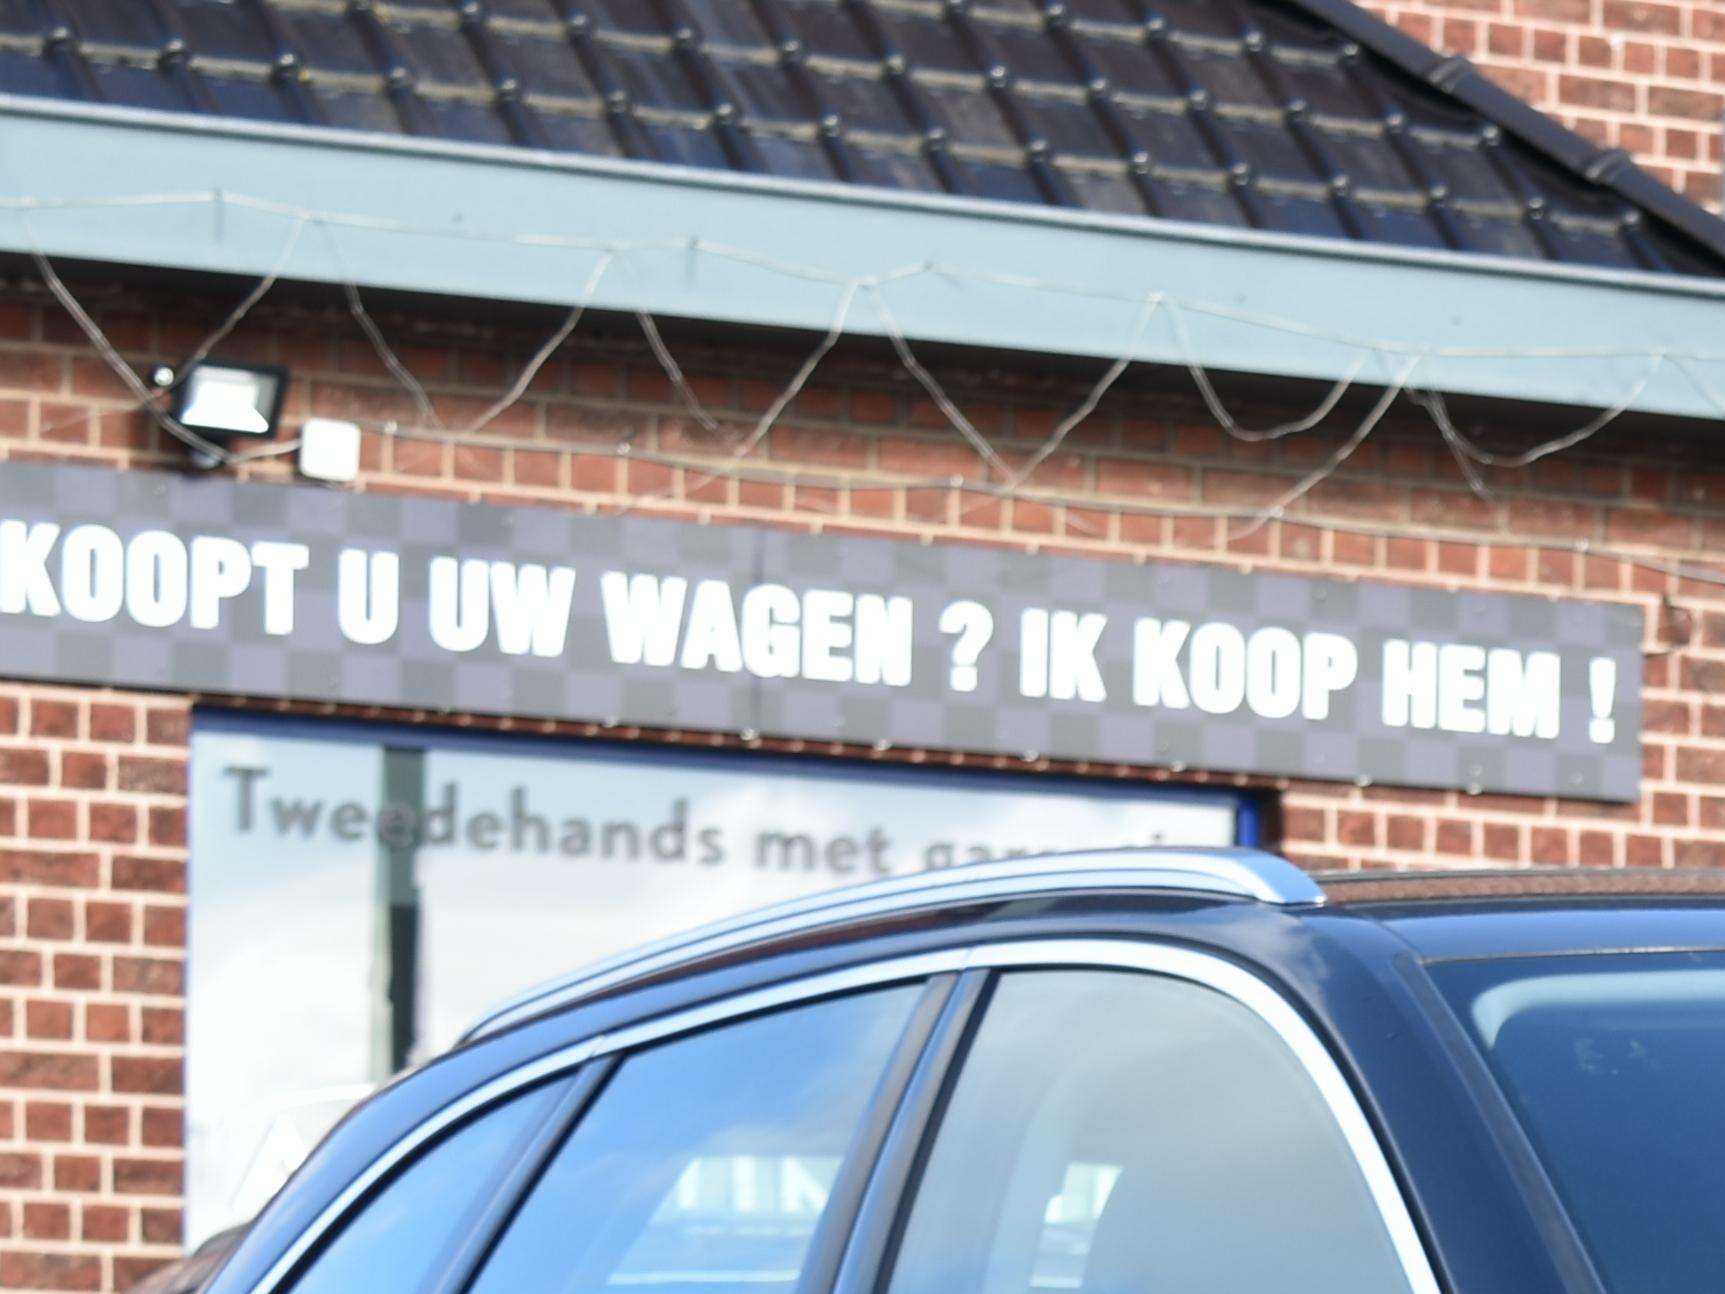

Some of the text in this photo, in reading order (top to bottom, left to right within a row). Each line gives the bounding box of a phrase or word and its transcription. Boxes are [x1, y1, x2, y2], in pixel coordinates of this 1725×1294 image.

[0, 519, 309, 636] KOOPT
[337, 549, 399, 645] U
[428, 556, 576, 657] UW
[600, 570, 912, 687] WAGEN
[1019, 608, 1108, 702] IK
[1133, 617, 1358, 720] KOOP
[1382, 640, 1560, 740] HEM
[223, 765, 726, 866] Tweedehands
[755, 826, 891, 874] met
